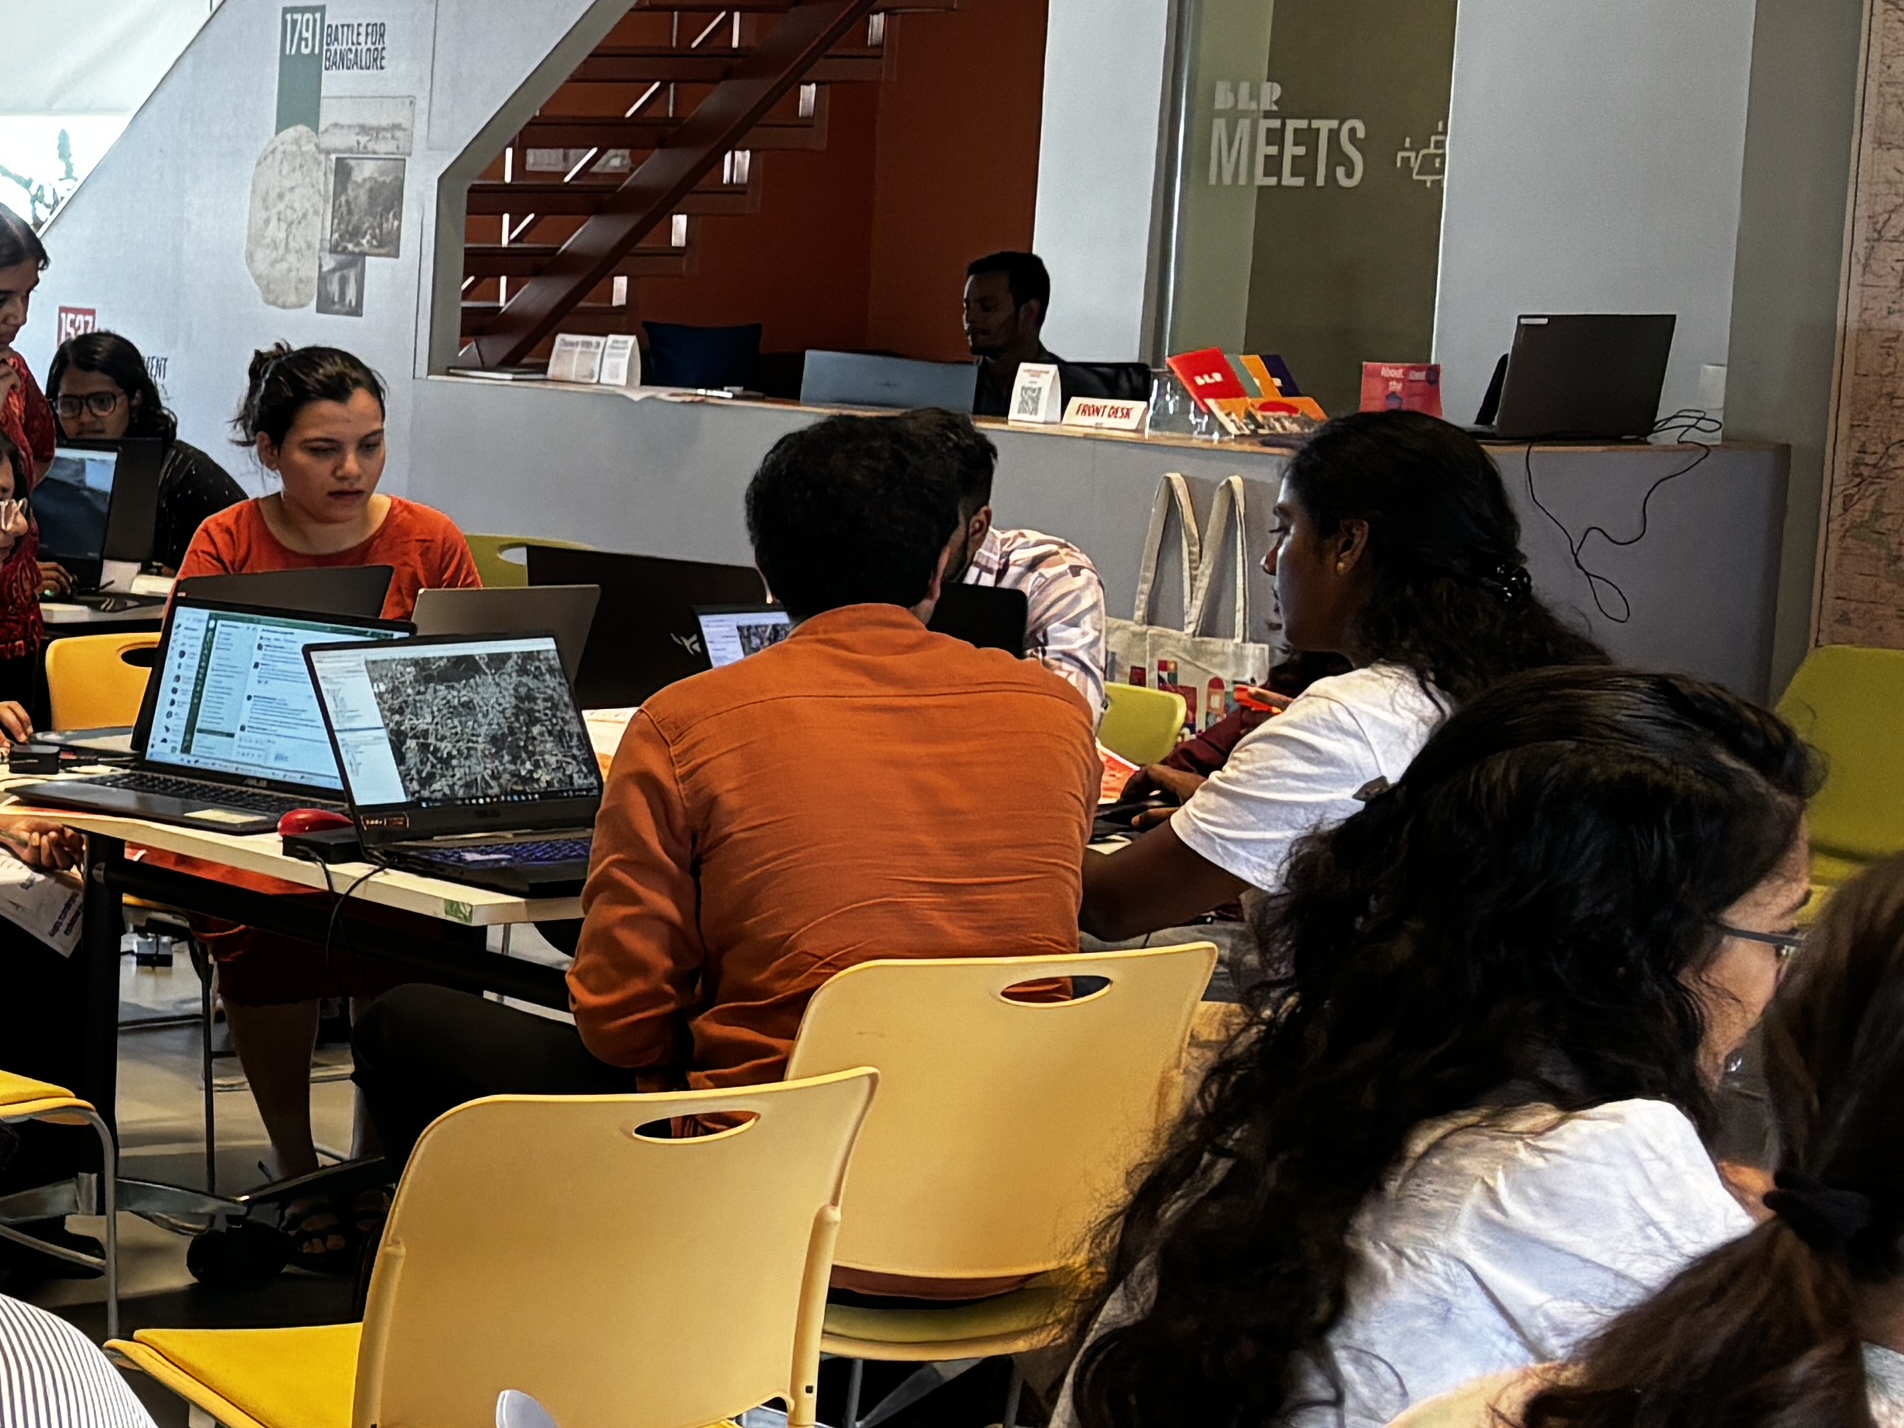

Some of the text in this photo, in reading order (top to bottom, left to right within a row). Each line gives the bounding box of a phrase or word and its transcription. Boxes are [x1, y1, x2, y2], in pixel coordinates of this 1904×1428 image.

[285, 12, 386, 55] 1791 BATTLE FOR
[324, 47, 386, 71] BANGALORE
[1214, 80, 1282, 111] BLR
[1208, 118, 1366, 188] MEETS
[1076, 403, 1134, 420] FRONT DESK
